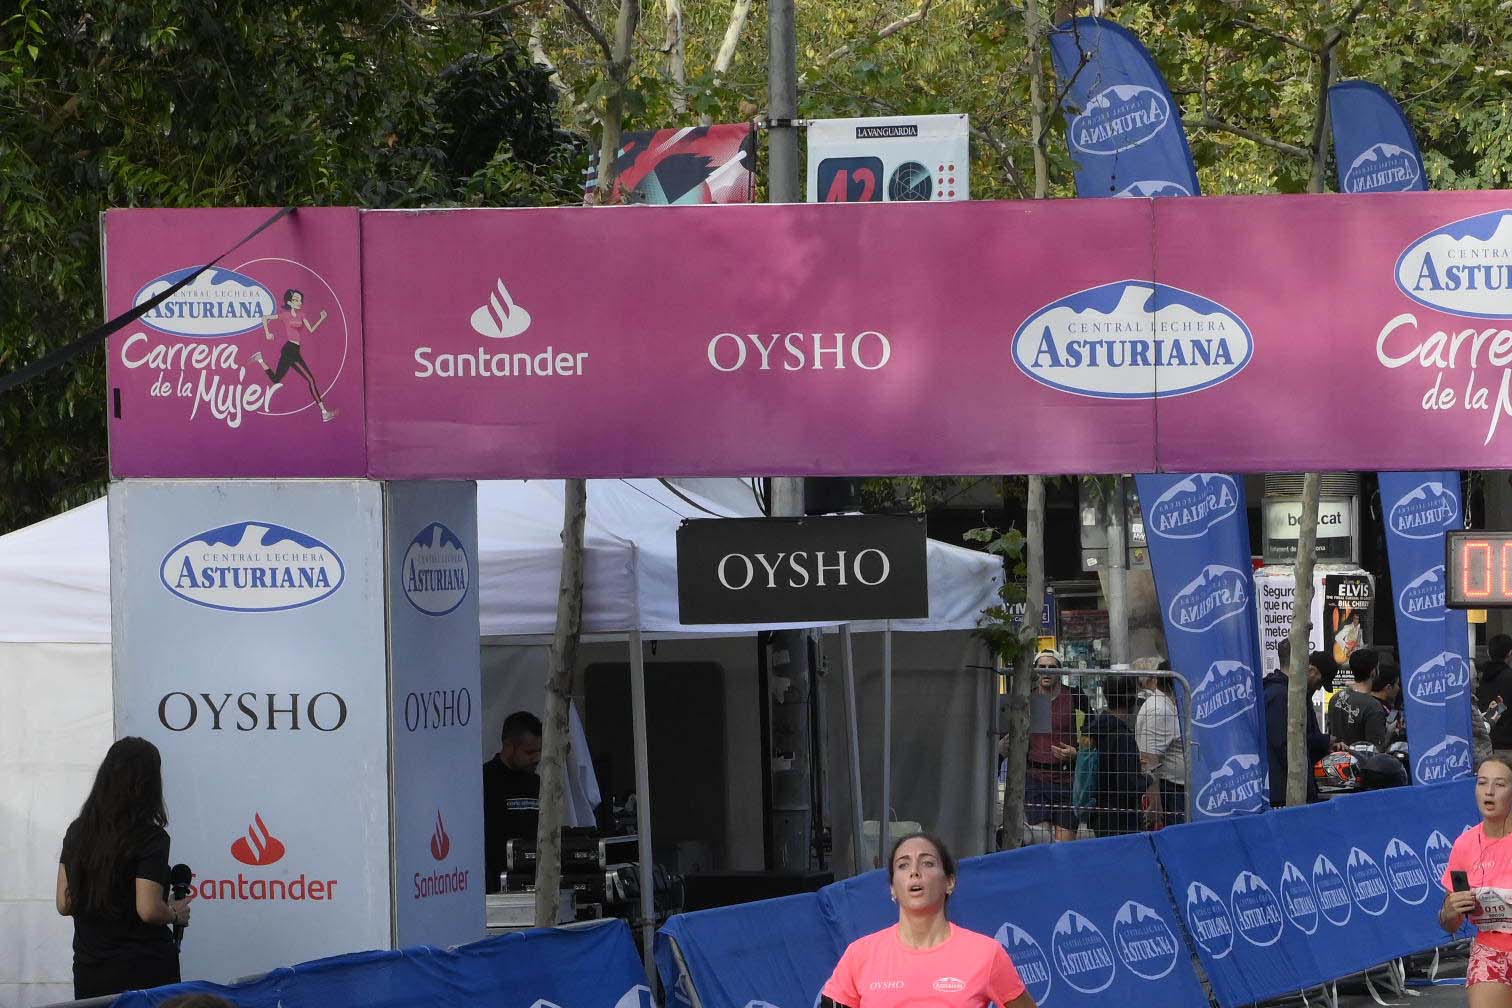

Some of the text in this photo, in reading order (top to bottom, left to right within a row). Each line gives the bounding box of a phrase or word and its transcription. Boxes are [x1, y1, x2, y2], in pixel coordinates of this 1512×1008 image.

[145, 292, 264, 319] ASTURIANA
[1068, 320, 1226, 333] CENTRAL LECHERA
[121, 332, 239, 369] Carrera
[414, 346, 589, 379] Santander
[707, 331, 892, 372] OYSHO
[1031, 325, 1235, 368] ASTURIANA
[151, 366, 284, 428] de la Mujer
[1422, 372, 1456, 410] de
[1465, 370, 1489, 410] la
[175, 555, 331, 589] ASTURIANA
[203, 552, 325, 562] CENTRAL LECHERA
[717, 549, 890, 590] OYSHO
[407, 558, 466, 593] ASTURIANA
[1338, 583, 1369, 596] ELVIS
[158, 692, 348, 732] OYSHO
[404, 687, 471, 732] OYSHO
[414, 868, 469, 899] Santander
[1058, 944, 1112, 975] ASTURIANA
